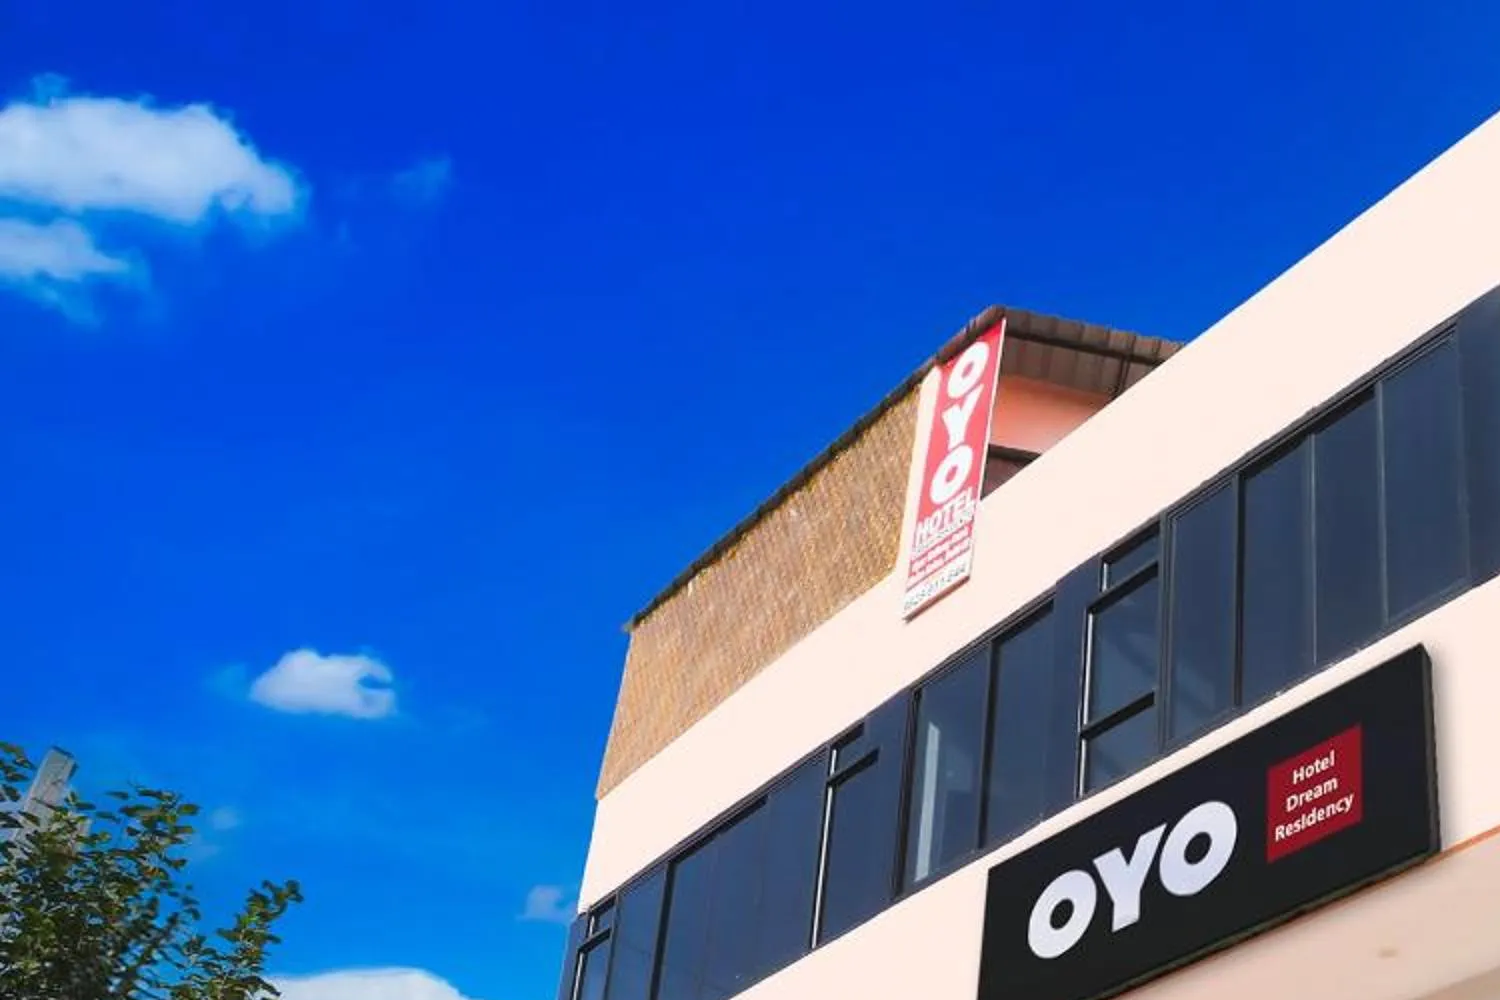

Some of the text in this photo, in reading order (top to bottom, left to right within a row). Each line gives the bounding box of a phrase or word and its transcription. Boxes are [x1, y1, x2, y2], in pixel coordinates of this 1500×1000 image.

[930, 340, 990, 505] OYO
[1292, 749, 1336, 785] Hotel
[1275, 792, 1355, 842] Residency
[1286, 777, 1339, 812] Dream
[1027, 800, 1238, 960] OYO
